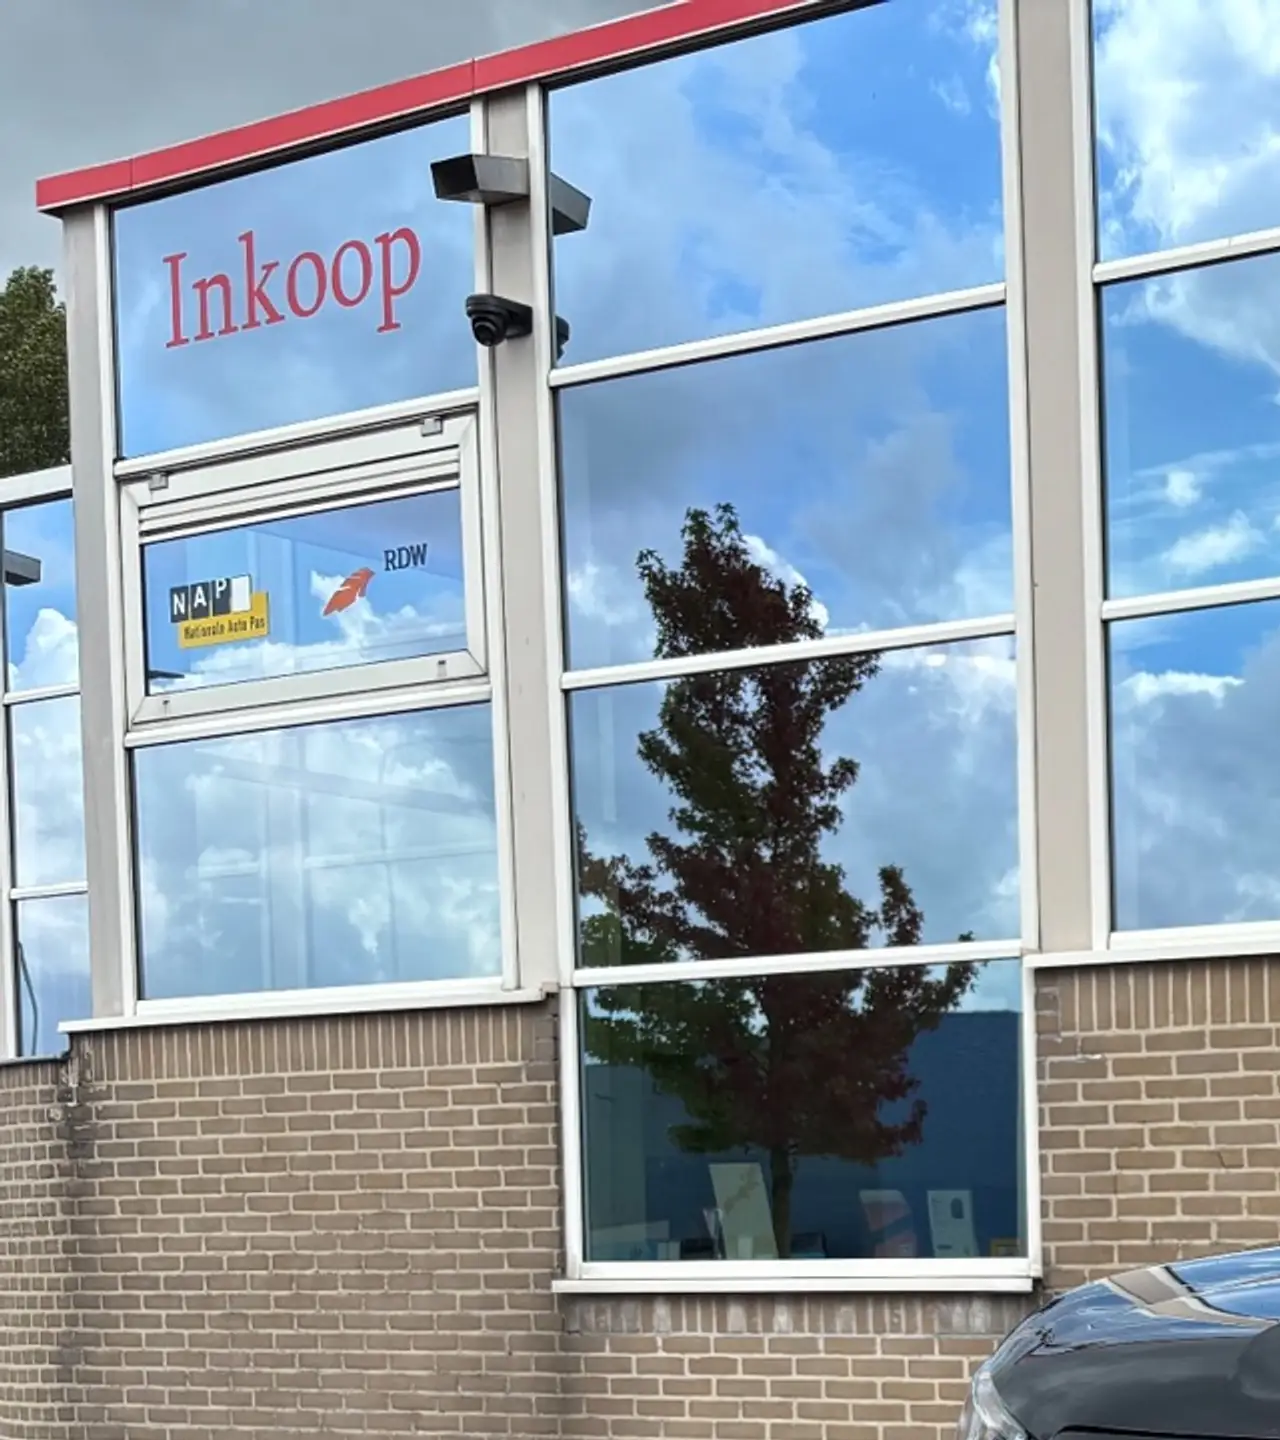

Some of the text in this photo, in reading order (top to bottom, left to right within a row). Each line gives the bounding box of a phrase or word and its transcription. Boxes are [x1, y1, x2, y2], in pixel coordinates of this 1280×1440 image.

[163, 227, 421, 348] Inkoop
[383, 543, 428, 573] RDW
[173, 578, 228, 616] NAP
